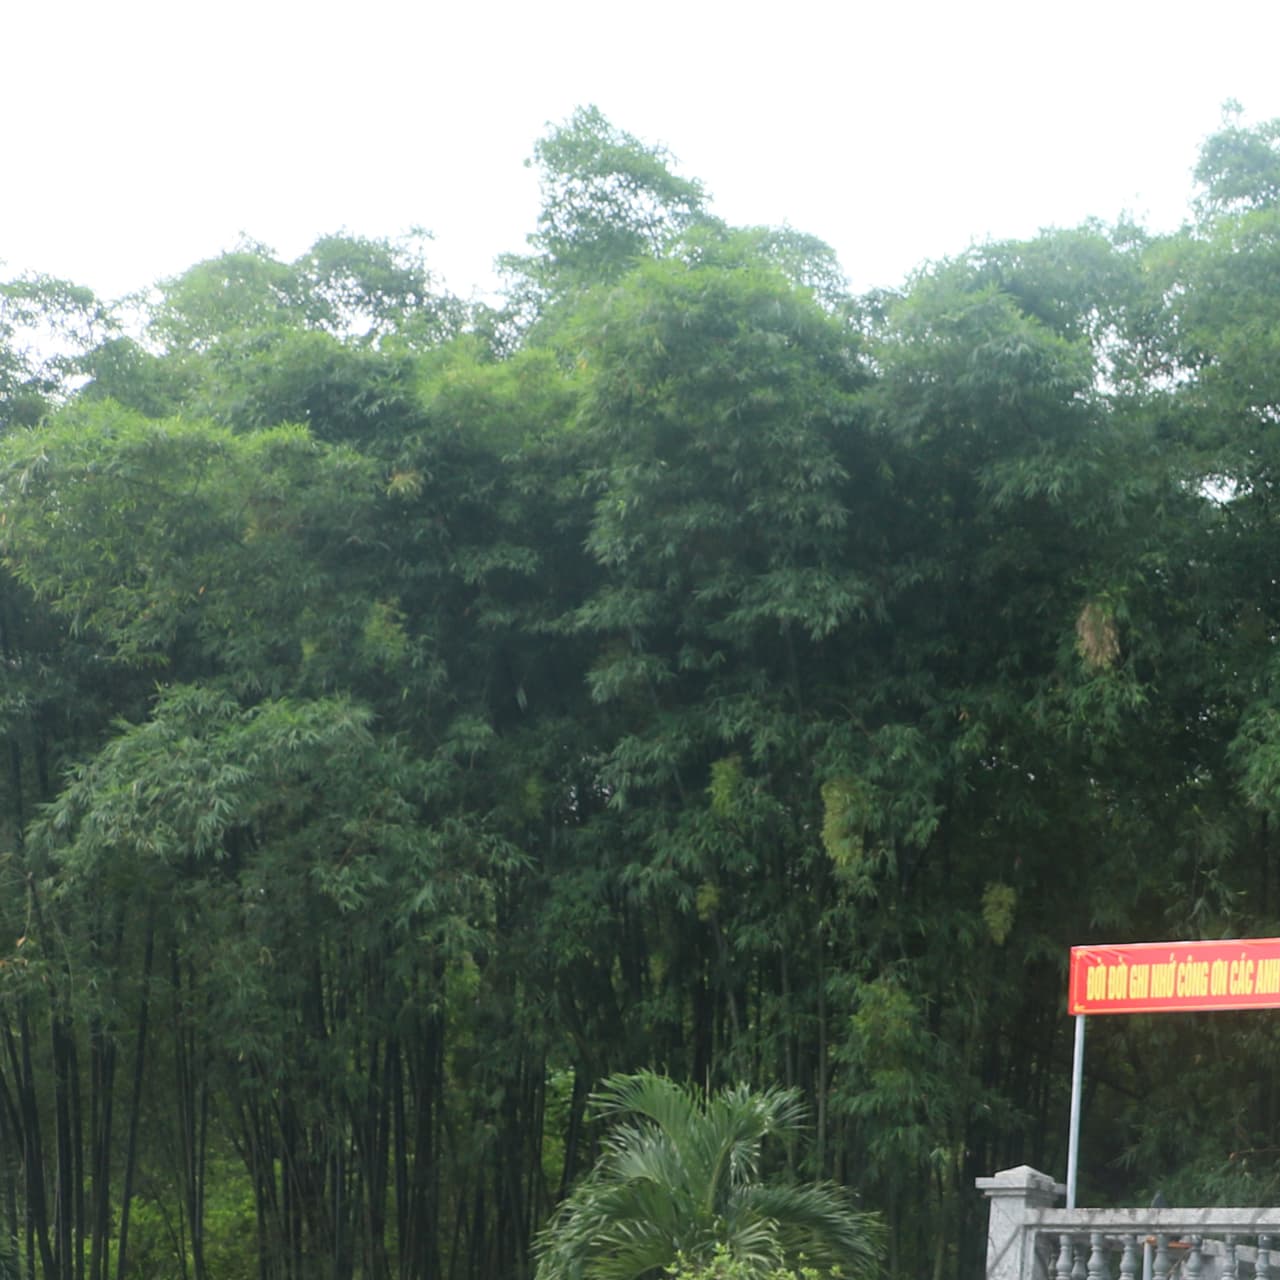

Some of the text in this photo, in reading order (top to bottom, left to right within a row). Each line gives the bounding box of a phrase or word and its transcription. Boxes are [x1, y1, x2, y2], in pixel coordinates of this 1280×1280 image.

[1086, 957, 1106, 1001] ĐỜI
[1107, 956, 1127, 1001] ĐỜI
[1129, 964, 1149, 999] GHI
[1150, 952, 1176, 998] NHỚ
[1176, 954, 1208, 997] CÔNG
[1229, 952, 1253, 995] CÁC
[1254, 958, 1280, 994] ANH
